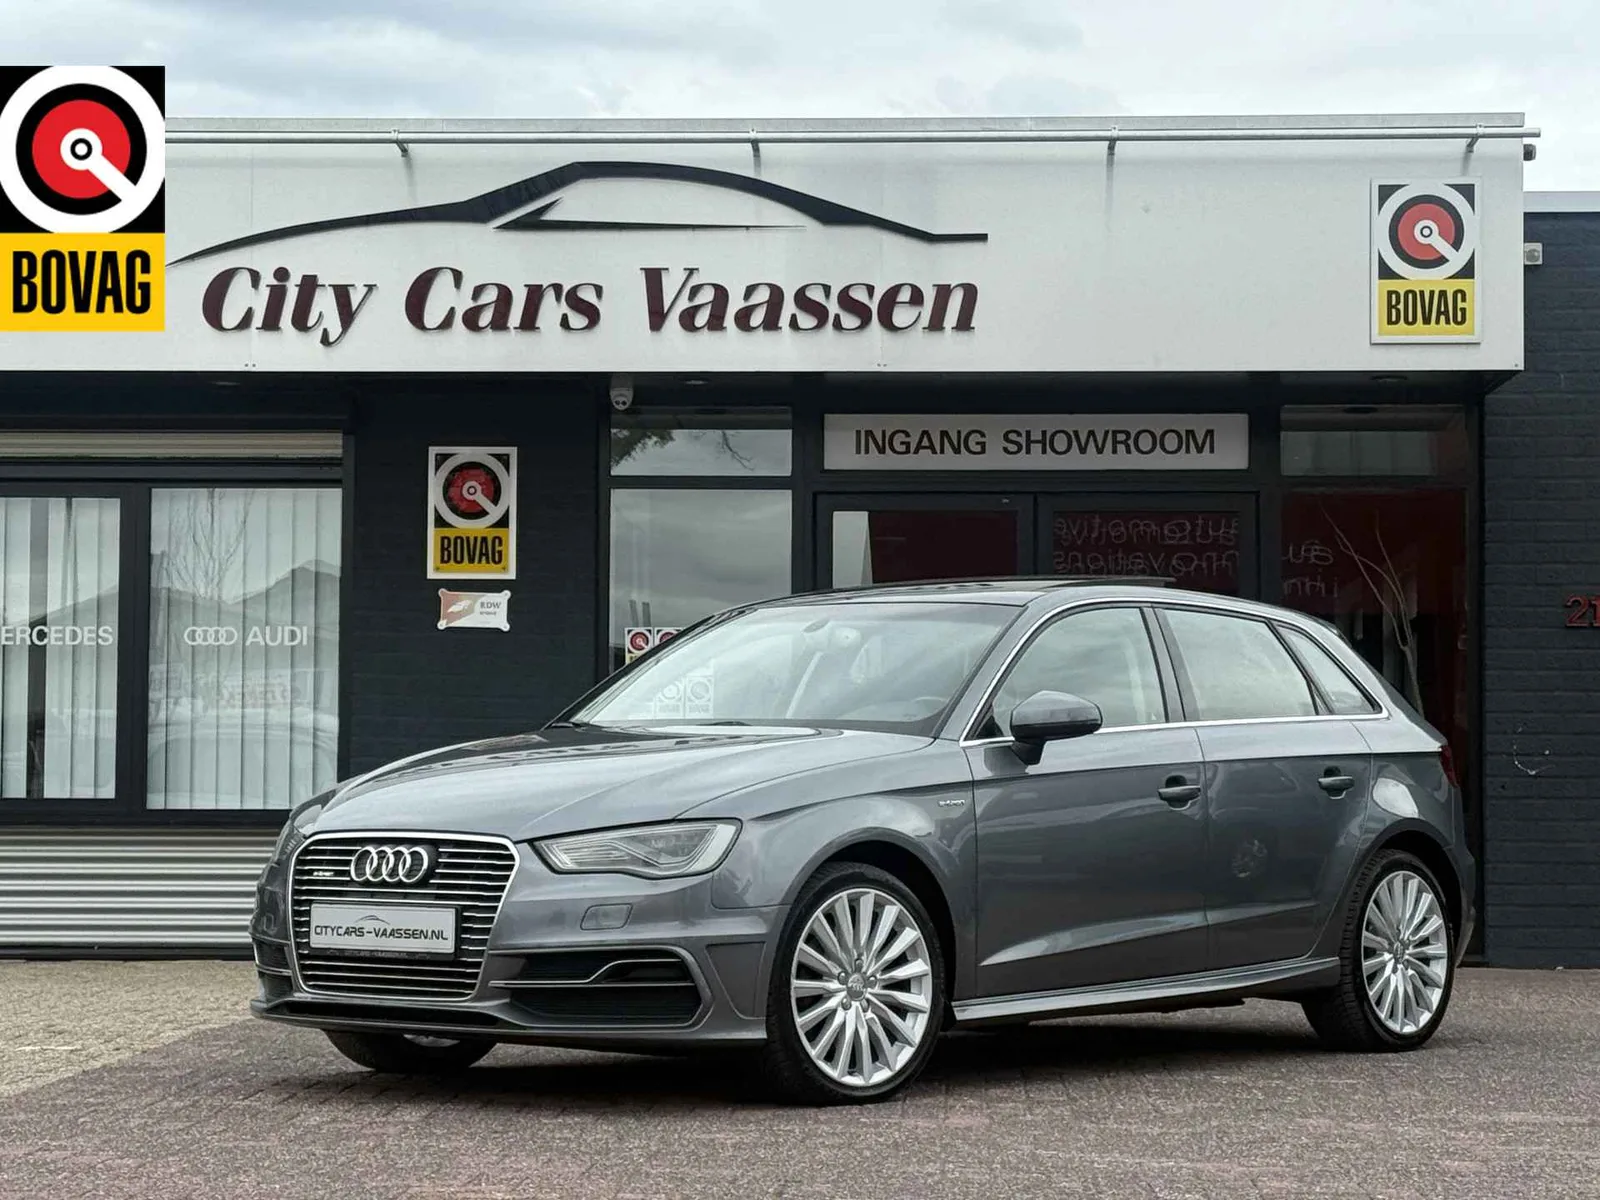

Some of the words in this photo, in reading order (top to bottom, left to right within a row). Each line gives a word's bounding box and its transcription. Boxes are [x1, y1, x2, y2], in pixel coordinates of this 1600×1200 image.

[202, 266, 377, 347] City
[404, 266, 603, 332] Cars
[639, 267, 979, 333] Vaassen
[1387, 289, 1467, 326] BOVAG
[855, 429, 987, 455] INGANG
[1002, 429, 1215, 455] SHOWROOM
[440, 536, 503, 565] BOVAG
[245, 626, 307, 646] AUDI
[315, 925, 448, 940] CITYCARS-VAASSEN.NL
